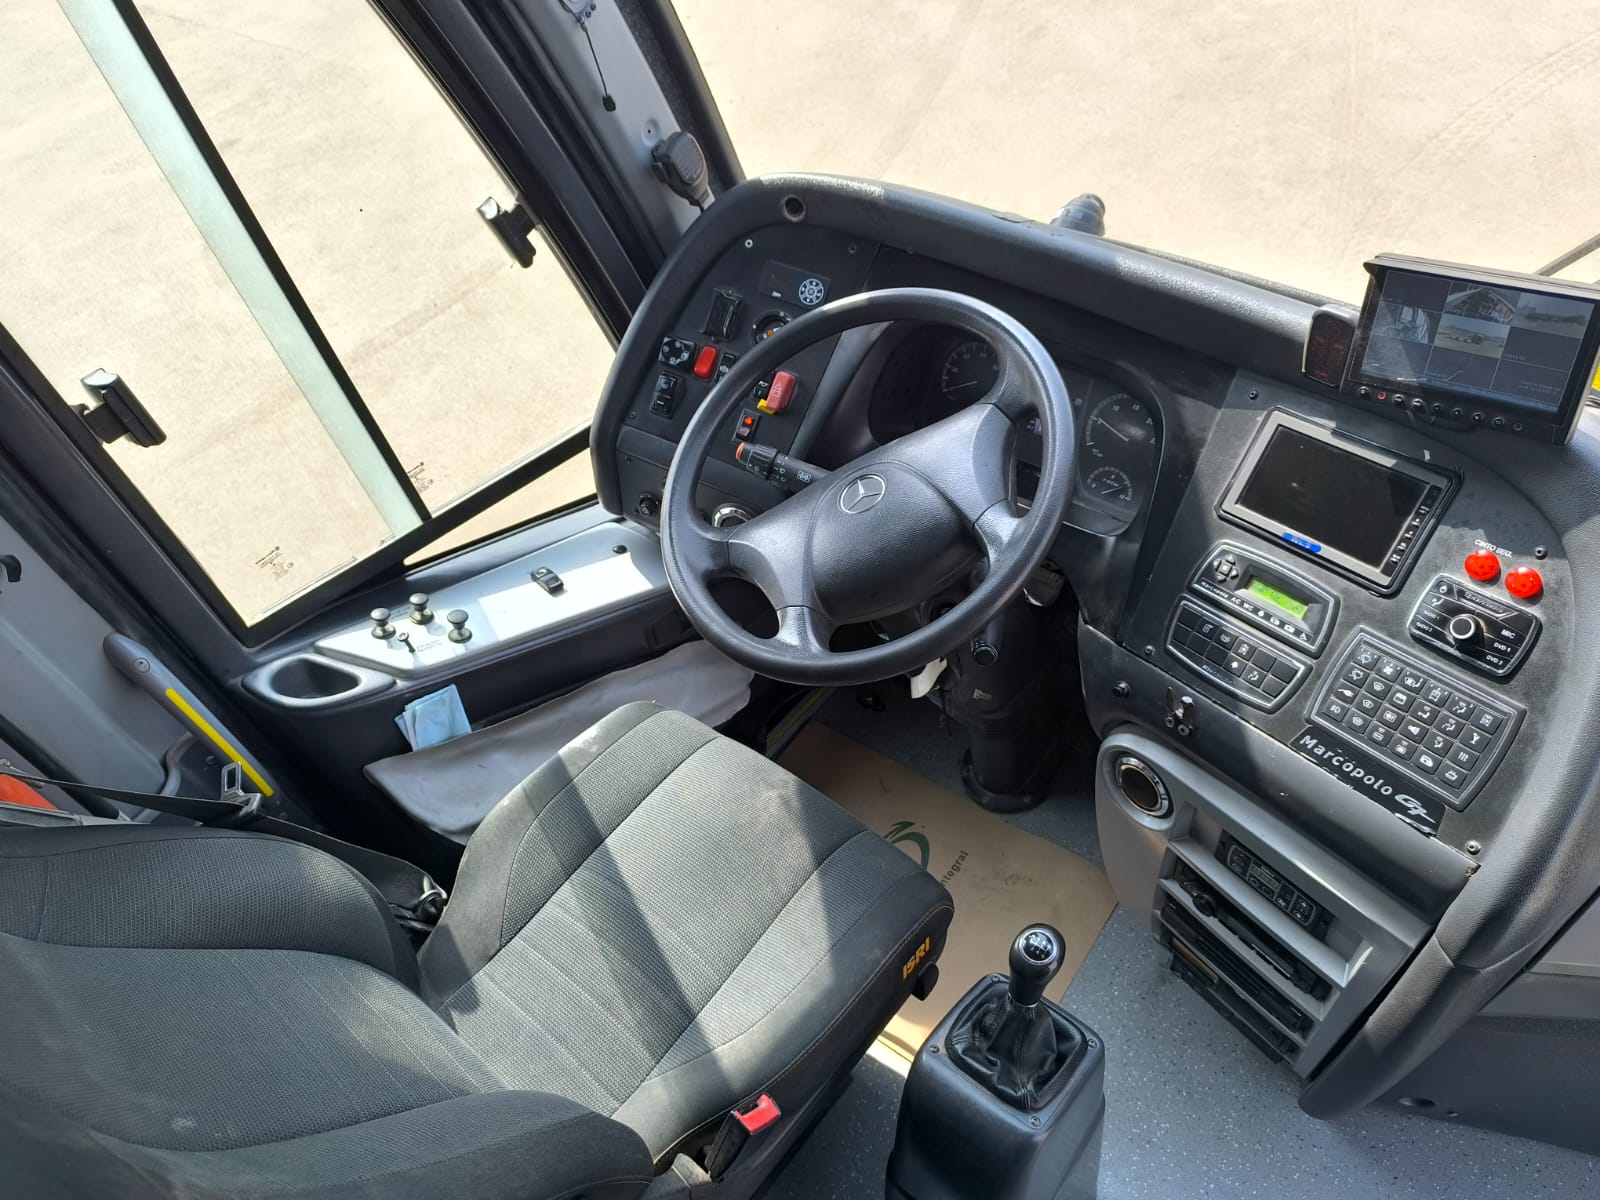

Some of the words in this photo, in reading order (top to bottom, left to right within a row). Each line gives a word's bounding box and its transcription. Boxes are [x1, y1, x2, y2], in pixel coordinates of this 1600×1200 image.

[1474, 539, 1497, 552] CINTO
[1501, 629, 1516, 639] MIC
[1493, 641, 1507, 651] DVD
[1486, 654, 1499, 664] DVD
[1300, 735, 1393, 796] Marcopolo
[902, 936, 931, 980] ISRI
